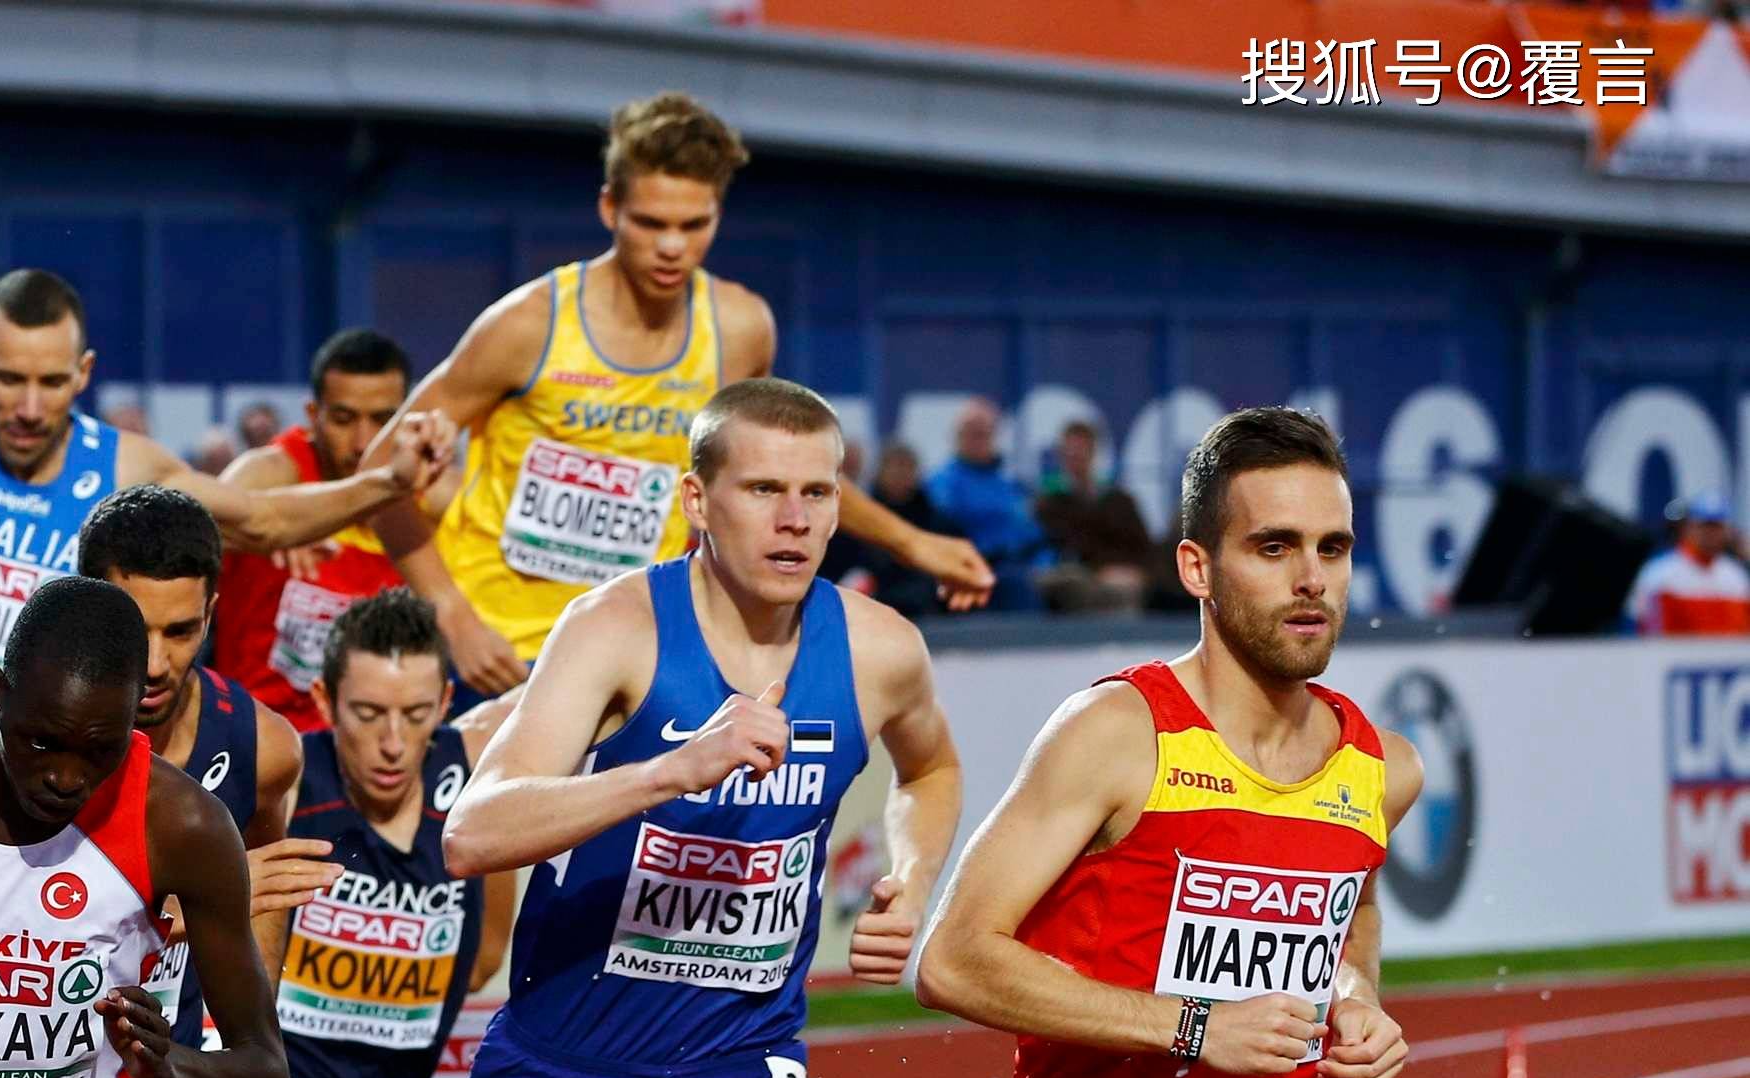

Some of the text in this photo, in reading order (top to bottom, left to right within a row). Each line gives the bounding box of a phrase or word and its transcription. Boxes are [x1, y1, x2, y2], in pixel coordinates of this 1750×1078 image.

[562, 400, 695, 437] SWEDEN
[529, 447, 638, 495] SPAR
[1166, 767, 1237, 795] Joma
[643, 836, 778, 881] SPAR
[330, 869, 467, 916] FRANCE
[632, 878, 804, 936] KIVISTIK
[1183, 872, 1326, 919] SPAR
[301, 902, 423, 950] SPAR
[296, 940, 441, 999] KOWAL
[612, 951, 790, 986] AMSTERDAM 2016
[672, 942, 708, 957] RUN
[711, 944, 766, 961] CLEAN
[1172, 922, 1342, 993] MARTOS
[278, 1007, 394, 1039] AMSTERDAM
[1189, 1023, 1204, 1058] LIONS
